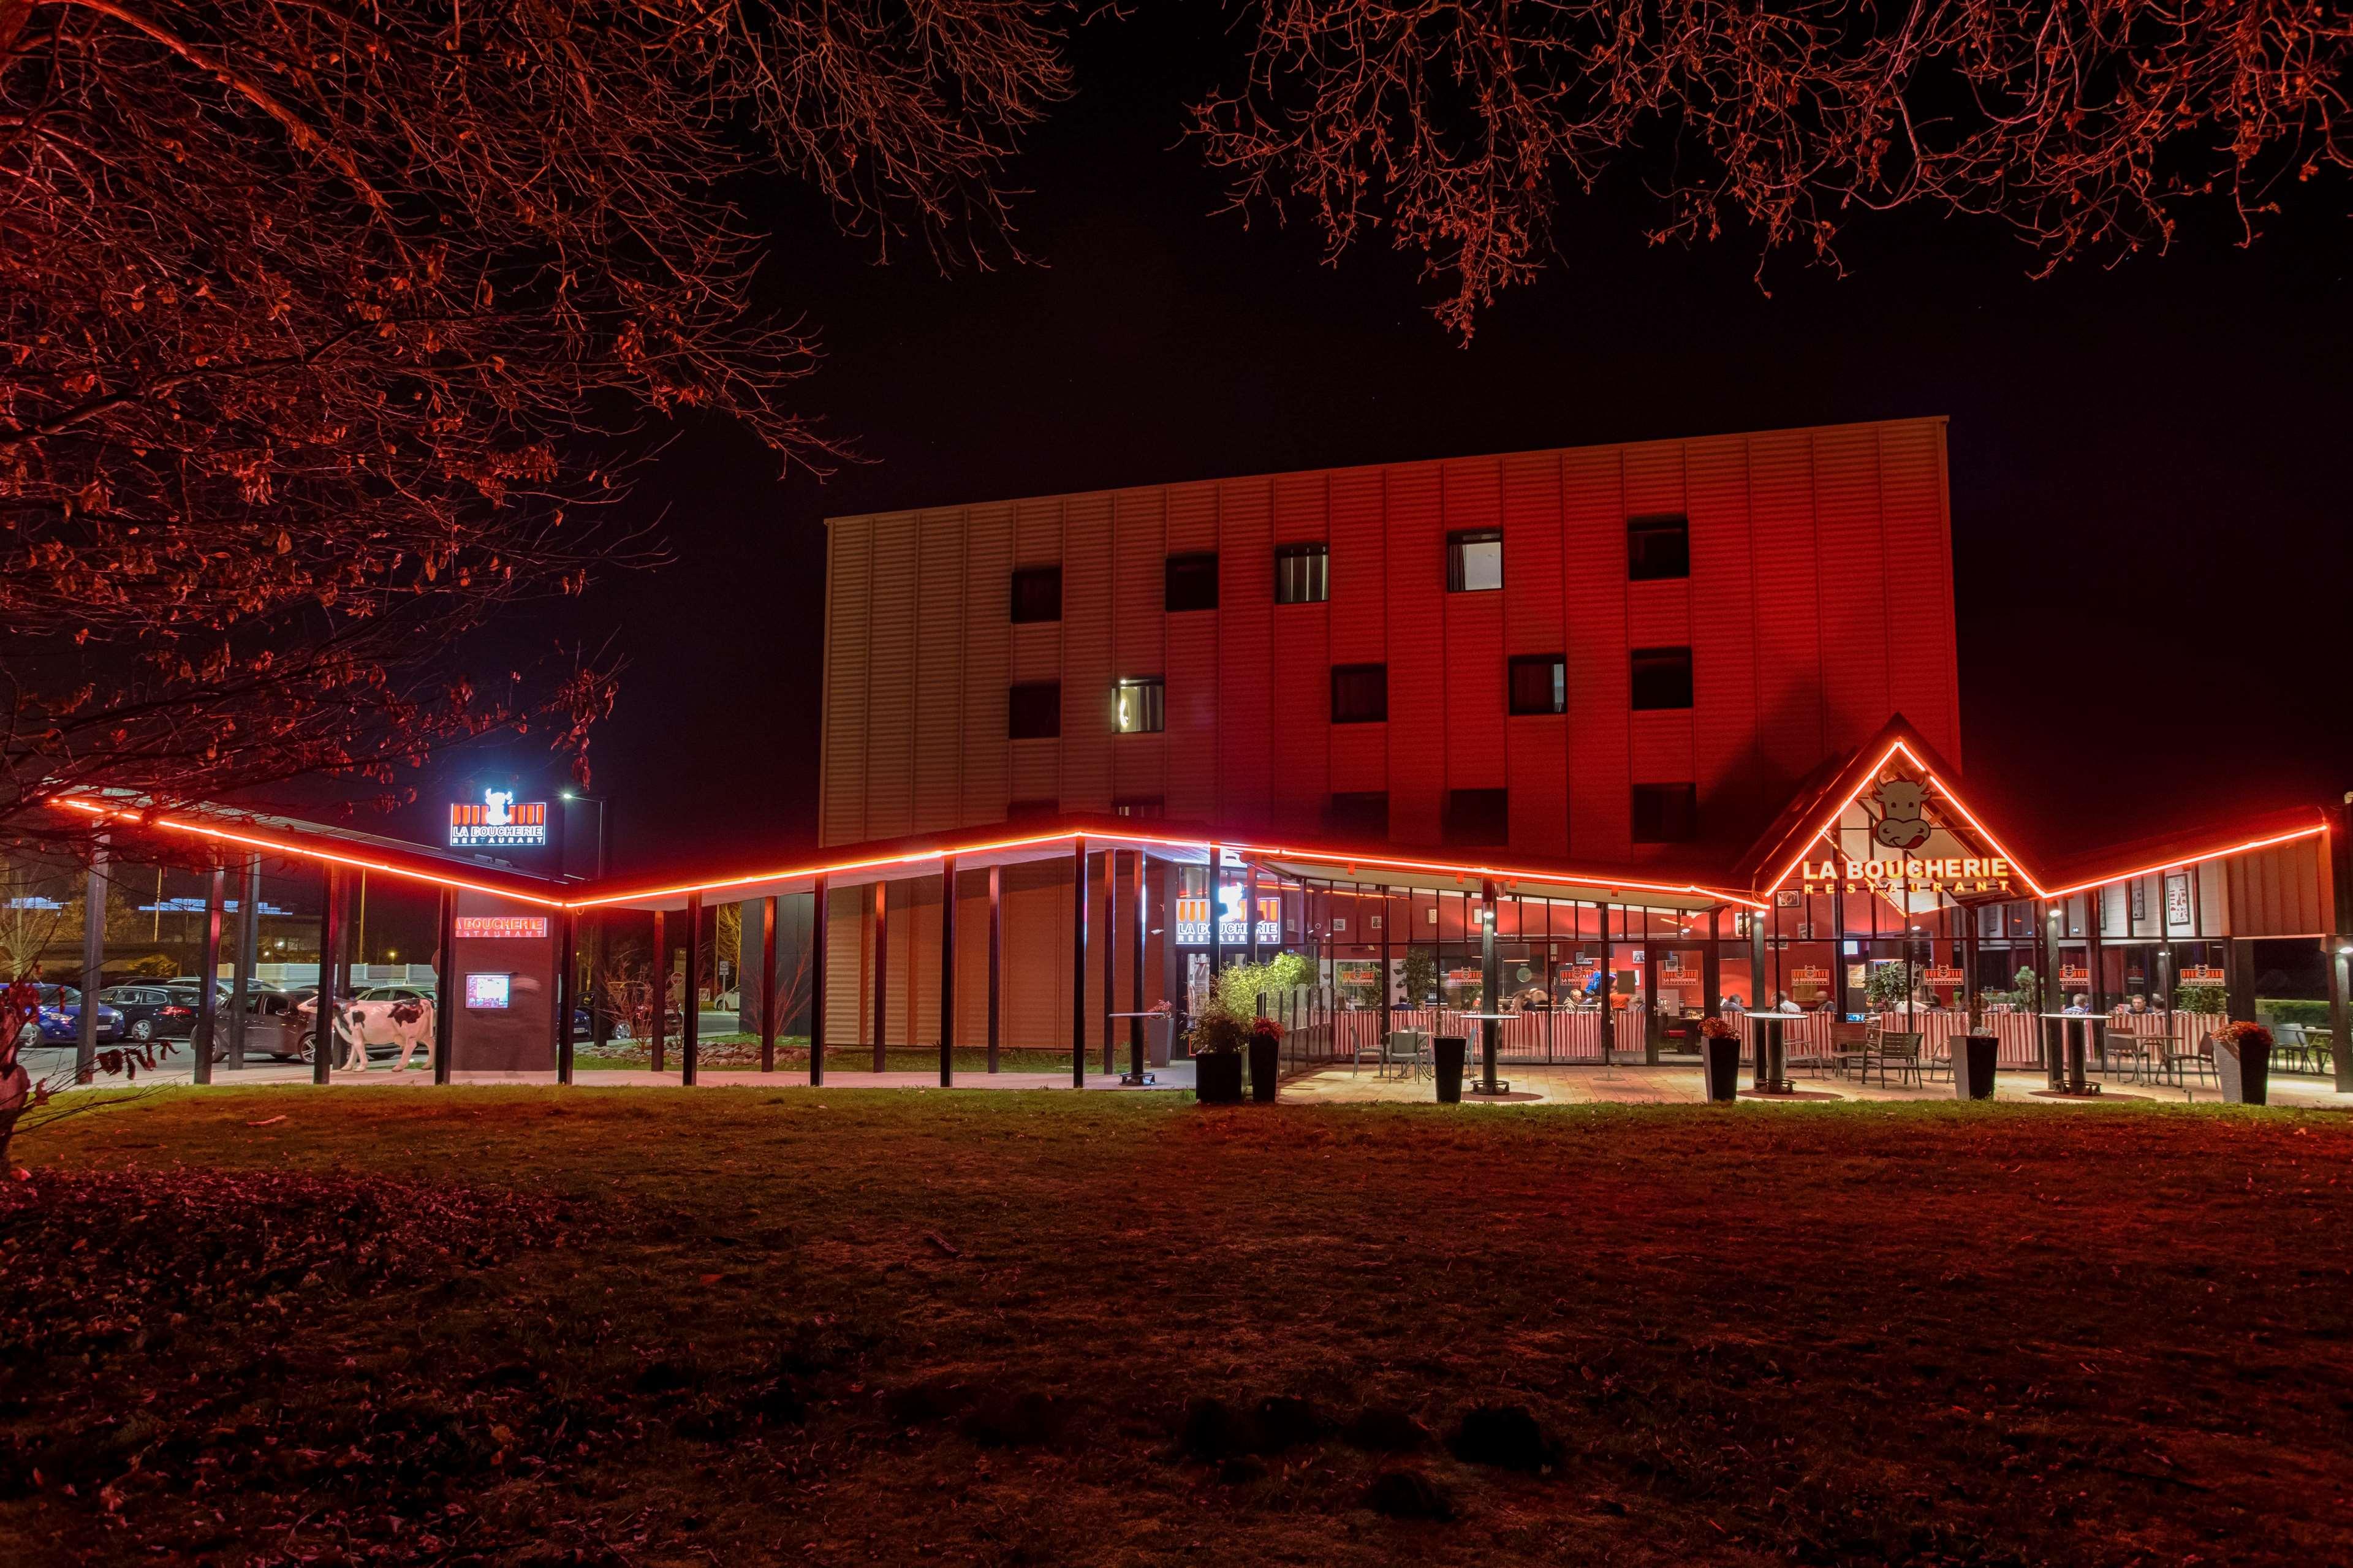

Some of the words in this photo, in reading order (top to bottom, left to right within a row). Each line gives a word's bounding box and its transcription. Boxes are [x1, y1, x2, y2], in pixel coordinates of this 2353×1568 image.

[453, 827, 469, 837] LA
[471, 826, 543, 837] BOUCHERIE
[1803, 860, 1838, 880] LA
[1846, 858, 2009, 879] BOUCHERIE
[1805, 881, 2009, 895] RESTAURANT
[464, 918, 543, 930] BOUCHERIE
[1178, 923, 1195, 934] LA
[1197, 922, 1278, 934] BUCHRIE
